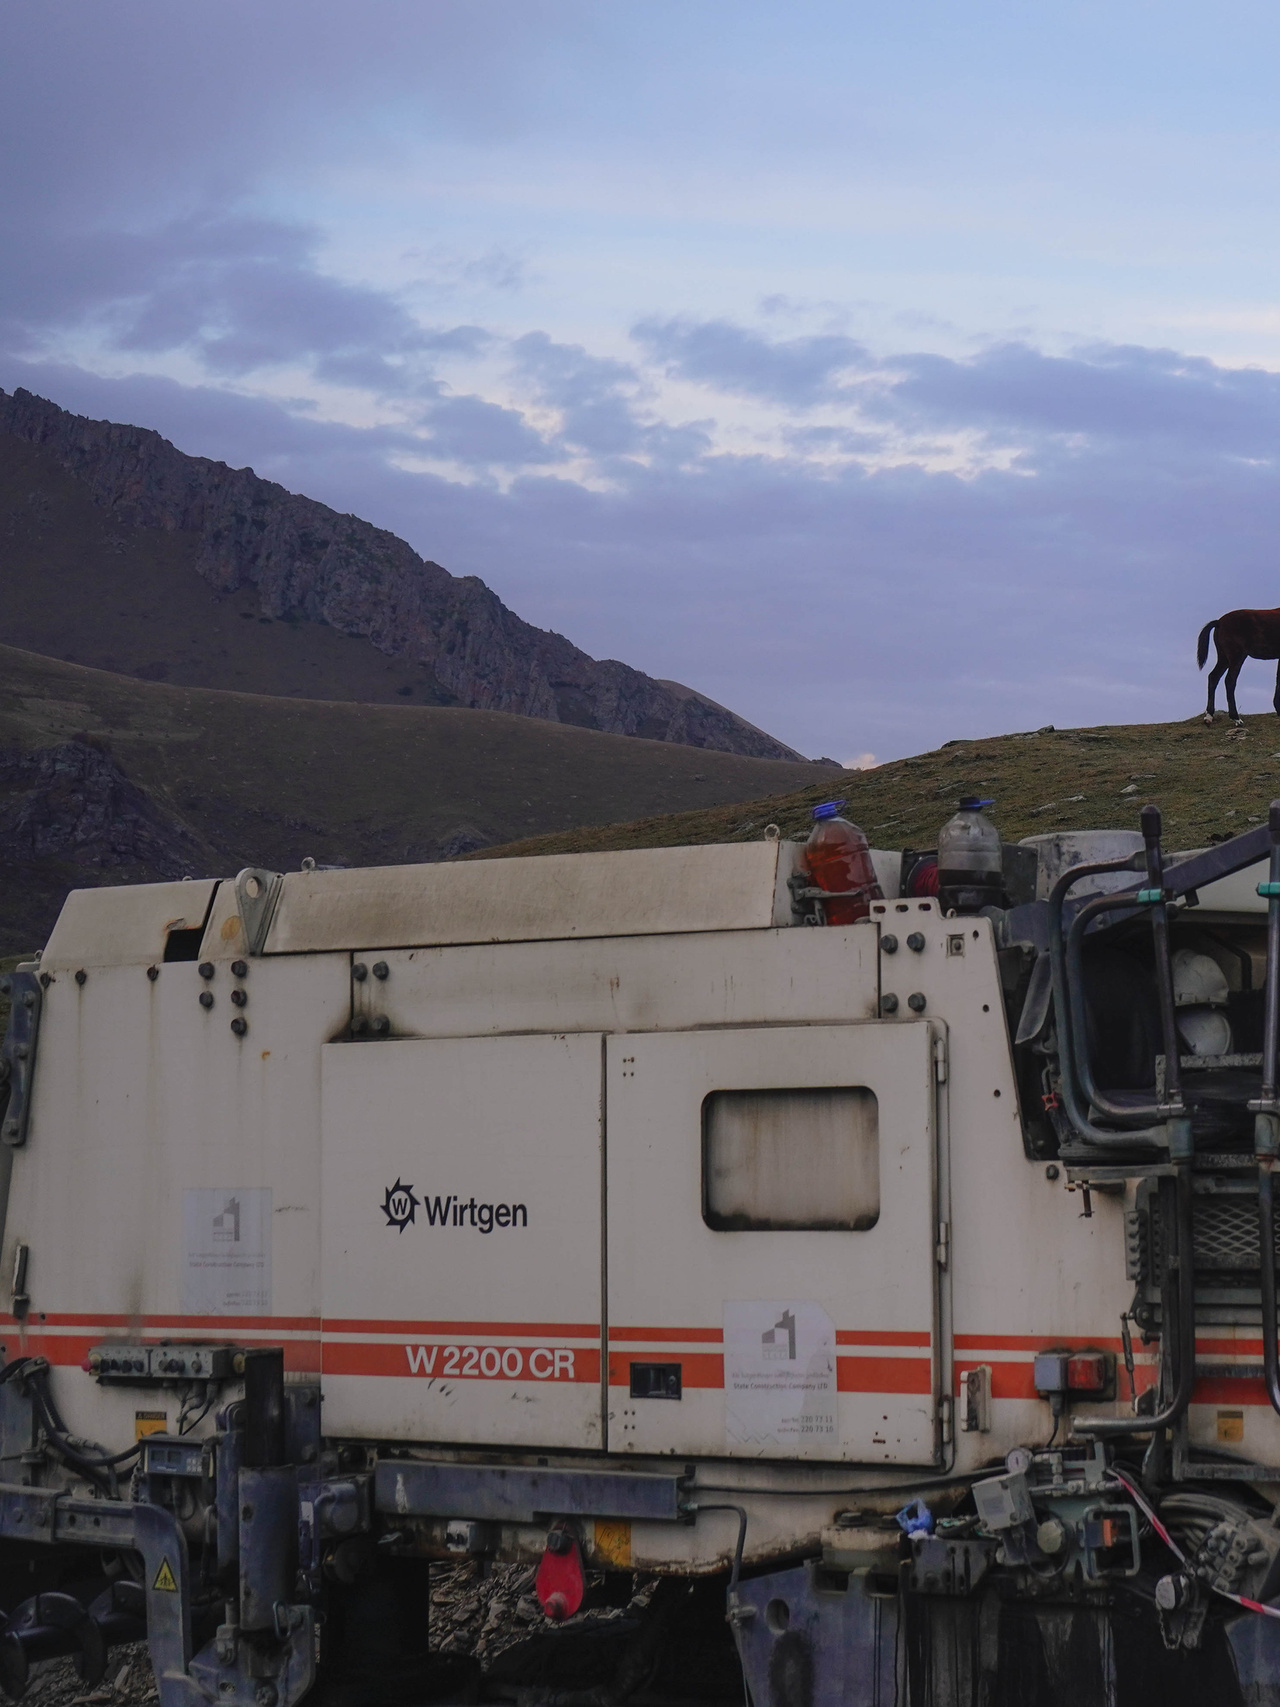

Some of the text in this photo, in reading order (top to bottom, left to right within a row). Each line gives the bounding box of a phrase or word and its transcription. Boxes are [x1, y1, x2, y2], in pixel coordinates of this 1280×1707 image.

[391, 1195, 528, 1234] W Wirtgen
[405, 1345, 576, 1380] W 2200 CR
[750, 1382, 787, 1390] Construction
[788, 1382, 816, 1391] Company
[801, 1425, 814, 1433] 220
